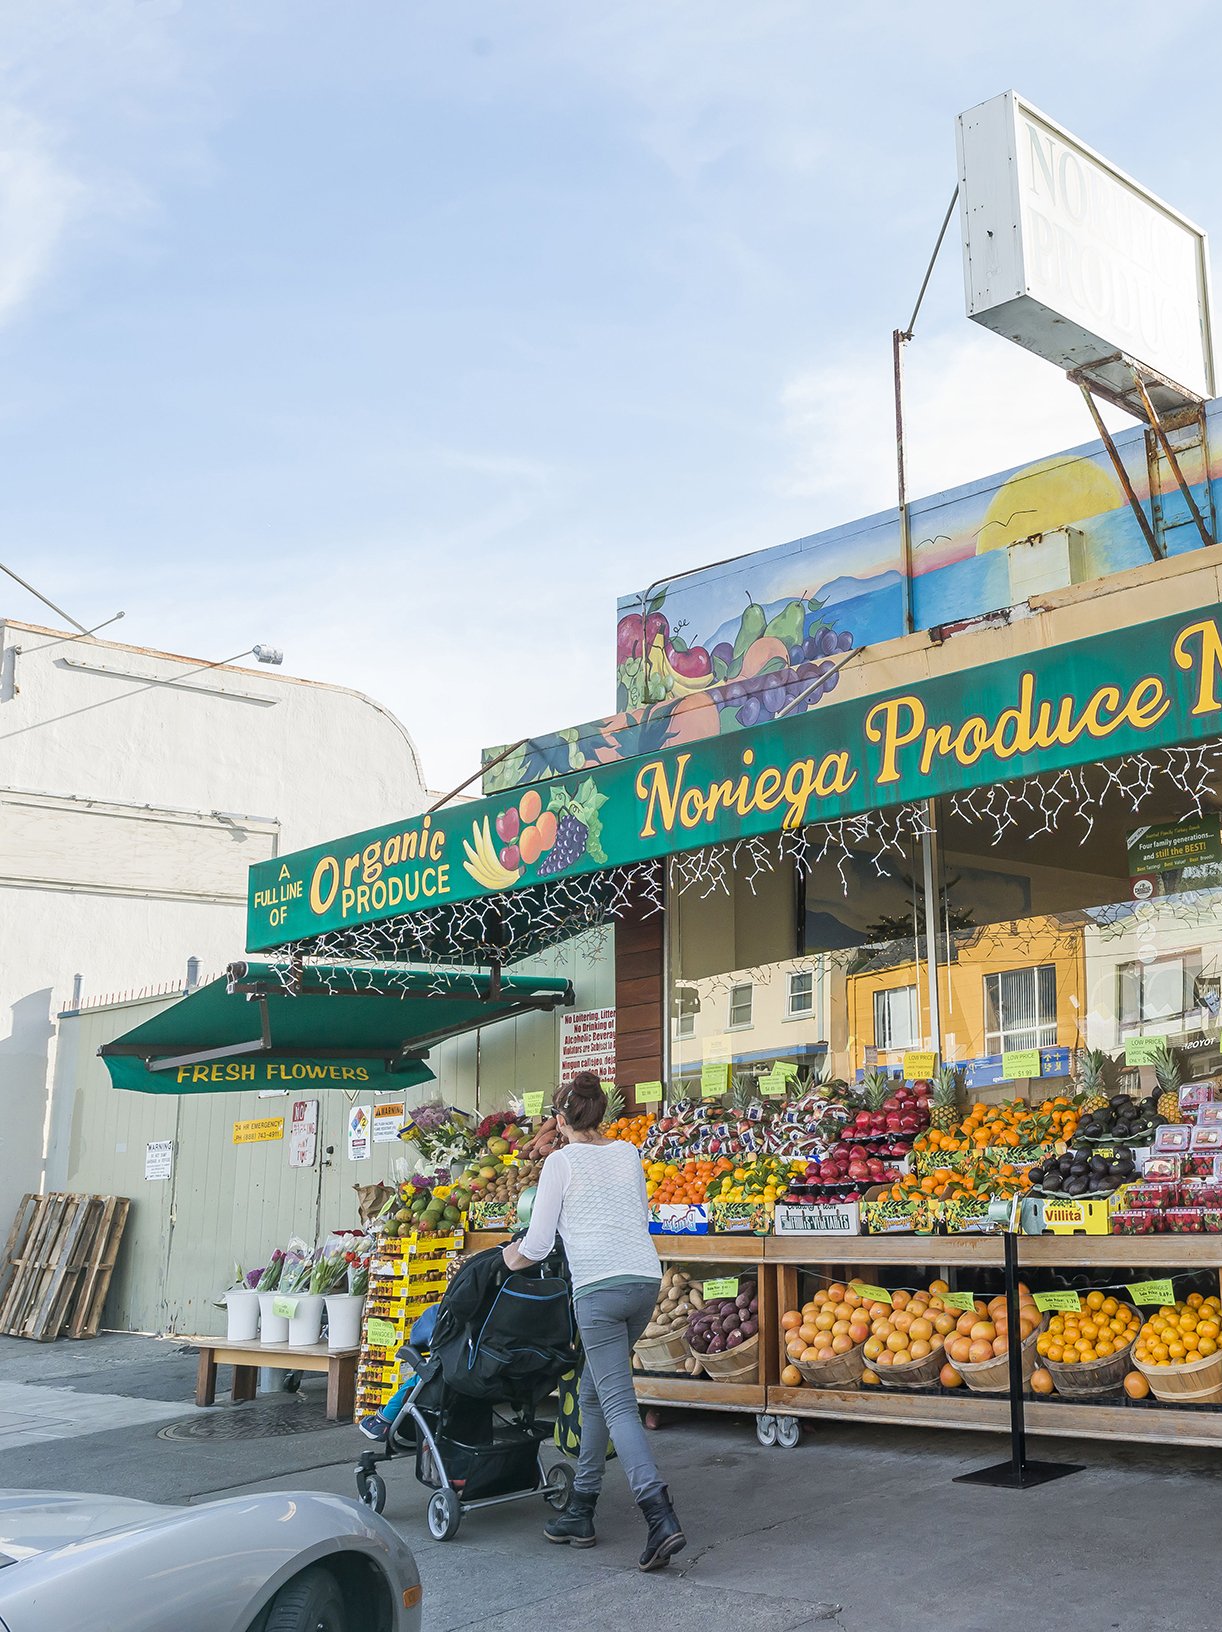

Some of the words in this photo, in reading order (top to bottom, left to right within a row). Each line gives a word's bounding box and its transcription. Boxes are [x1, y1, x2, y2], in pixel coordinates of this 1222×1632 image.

[635, 748, 857, 829] Noriega
[864, 671, 1172, 786] Produce
[1139, 842, 1153, 850] Four
[1153, 839, 1172, 848] family
[1143, 852, 1155, 861] and
[1155, 848, 1170, 859] still
[1171, 846, 1183, 856] the
[1184, 842, 1207, 853] BEST!
[278, 864, 291, 881] A
[309, 815, 445, 915] Organic
[254, 887, 278, 908] FULL
[281, 880, 303, 901] LINE
[342, 863, 450, 918] PRODUCE
[269, 906, 288, 927] OF
[574, 1025, 581, 1033] No
[583, 1021, 607, 1032] Drinking
[564, 1033, 591, 1045] Alcoholic
[177, 1063, 256, 1083] FRESH
[266, 1063, 370, 1081] FLOWERS
[1045, 1209, 1082, 1222] Villita
